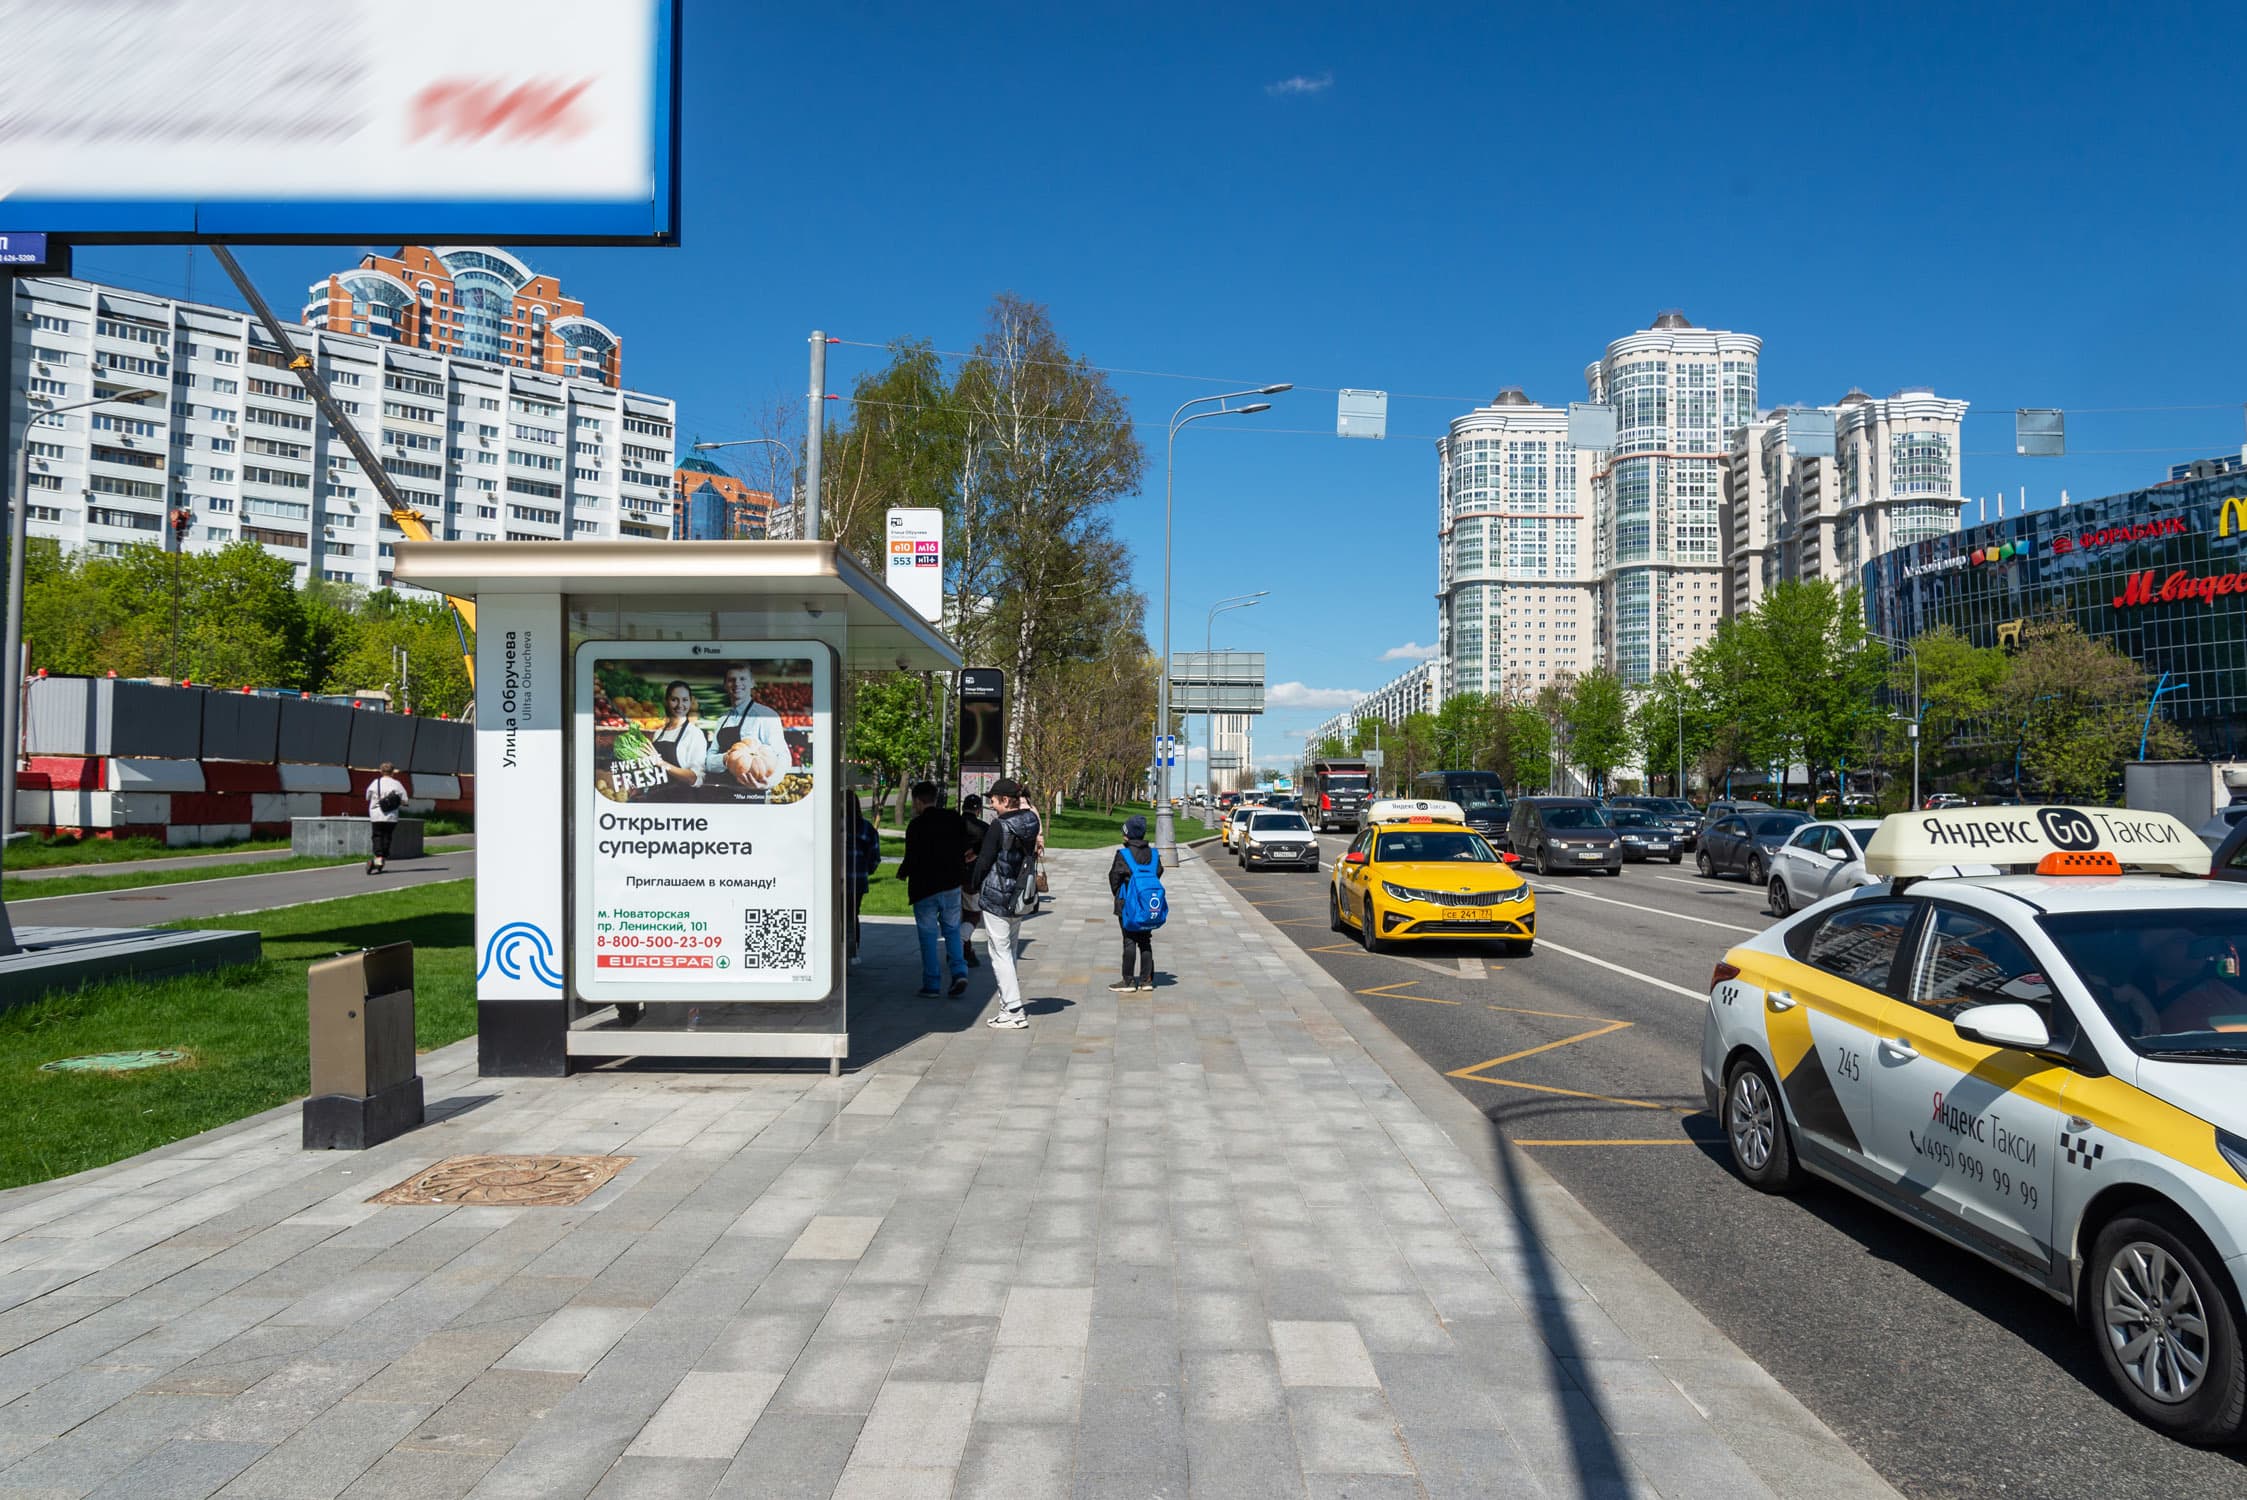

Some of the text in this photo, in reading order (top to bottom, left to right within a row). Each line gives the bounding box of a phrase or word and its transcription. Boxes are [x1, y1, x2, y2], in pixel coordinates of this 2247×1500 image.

[2079, 516, 2187, 548] ФОРАБАНК
[894, 543, 911, 552] е10
[893, 556, 911, 566] 553
[522, 631, 532, 721] Ulitsa Obrucheva
[502, 631, 519, 768] Улица Обручева
[612, 766, 669, 793] FRESH
[599, 813, 708, 835] Открытие
[1922, 812, 2181, 848] Яндекс Go Такси
[598, 839, 752, 859] супермаркета
[626, 876, 776, 889] Приглашаем в команду!
[597, 909, 690, 919] м. Новаторская
[1460, 910, 1476, 919] 241
[597, 921, 708, 932] пр. Ленинский, 101
[597, 935, 722, 948] 8-800-500-23-09
[609, 957, 713, 967] EUROSPAR
[1838, 1047, 1860, 1081] 245
[1932, 1091, 2036, 1168] Яндекс Такси
[1922, 1136, 2038, 1211] (495) 999 99 99
